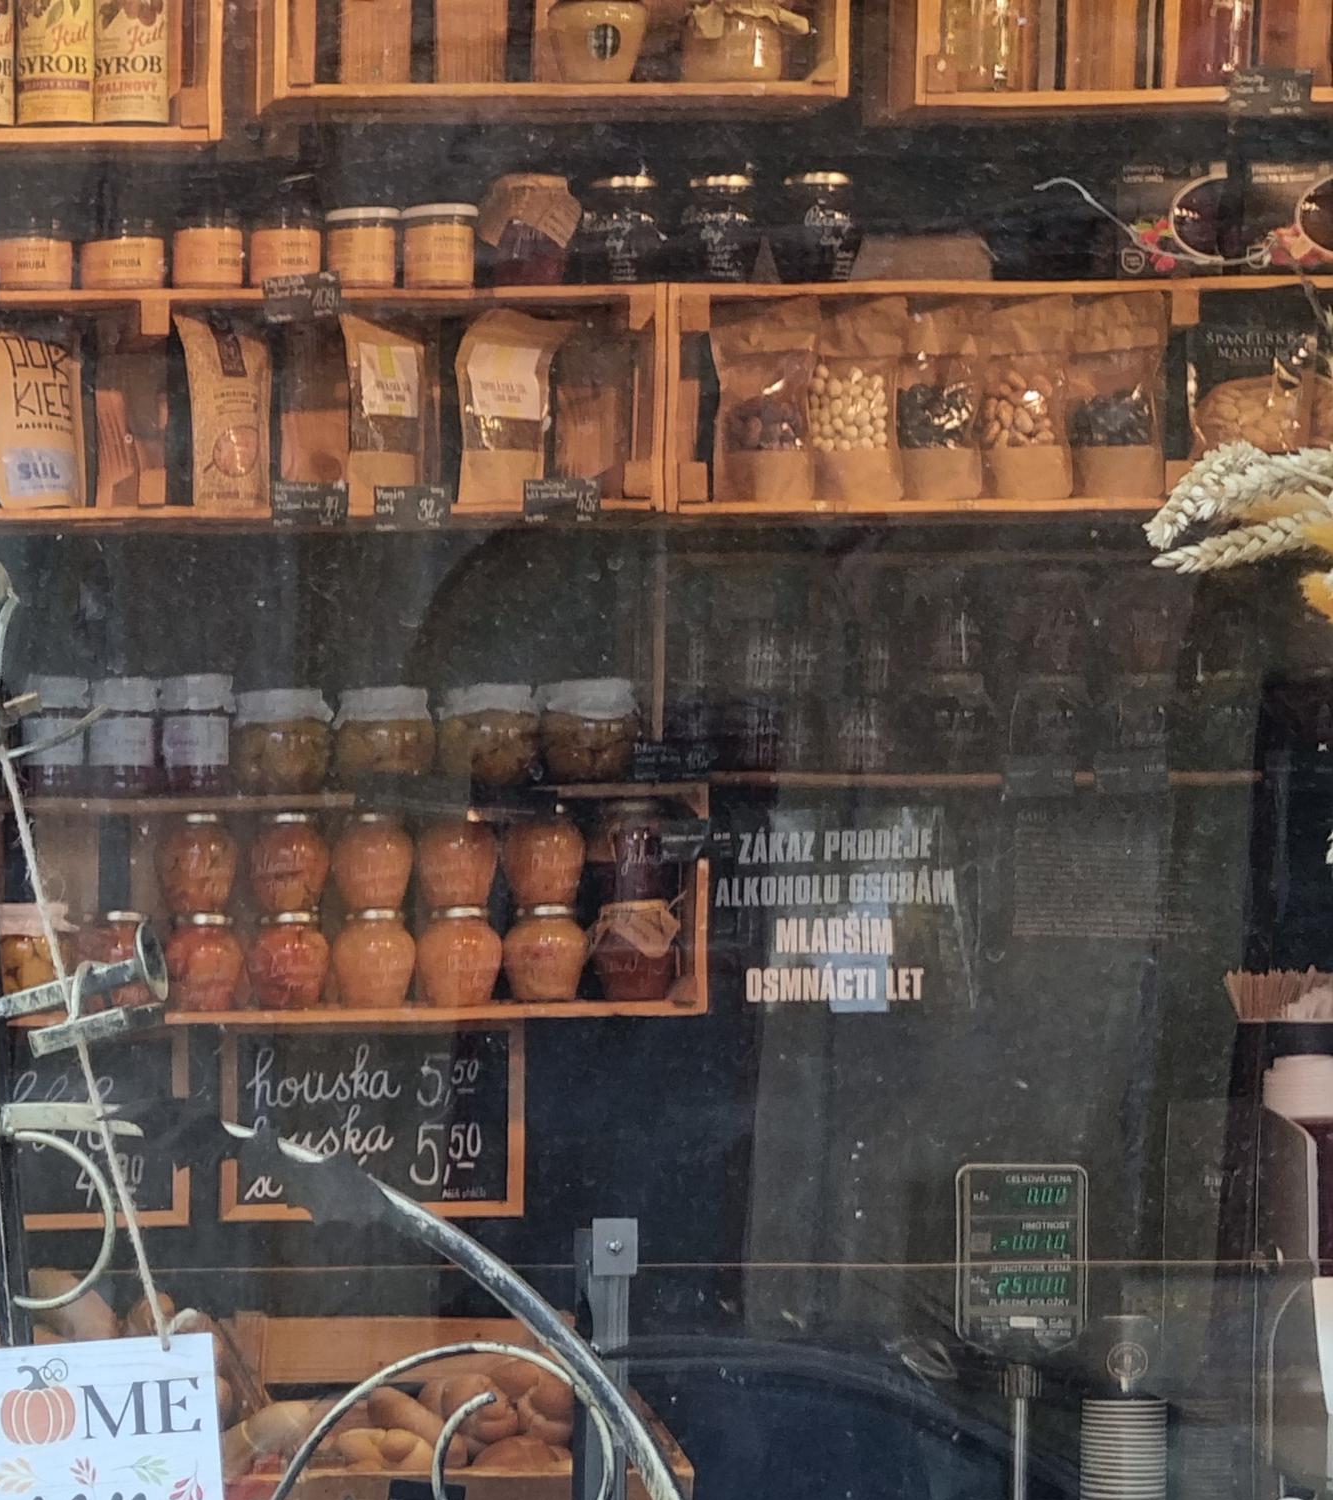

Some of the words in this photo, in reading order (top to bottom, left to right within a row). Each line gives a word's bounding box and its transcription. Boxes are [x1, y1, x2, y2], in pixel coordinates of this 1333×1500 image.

[18, 54, 88, 76] SYROB
[94, 55, 163, 78] SYROB
[738, 827, 816, 864] ZÁKAZ
[715, 874, 840, 907] ALKOHOLU
[849, 865, 957, 905] OSOBÁM
[776, 910, 894, 955] MLADŠÍM
[745, 961, 876, 1003] OSMNÁCTI
[886, 966, 925, 1001] LET
[246, 1044, 401, 1110] houska
[1048, 1174, 1072, 1184] CENA
[1022, 1221, 1071, 1231] HMOTNOST
